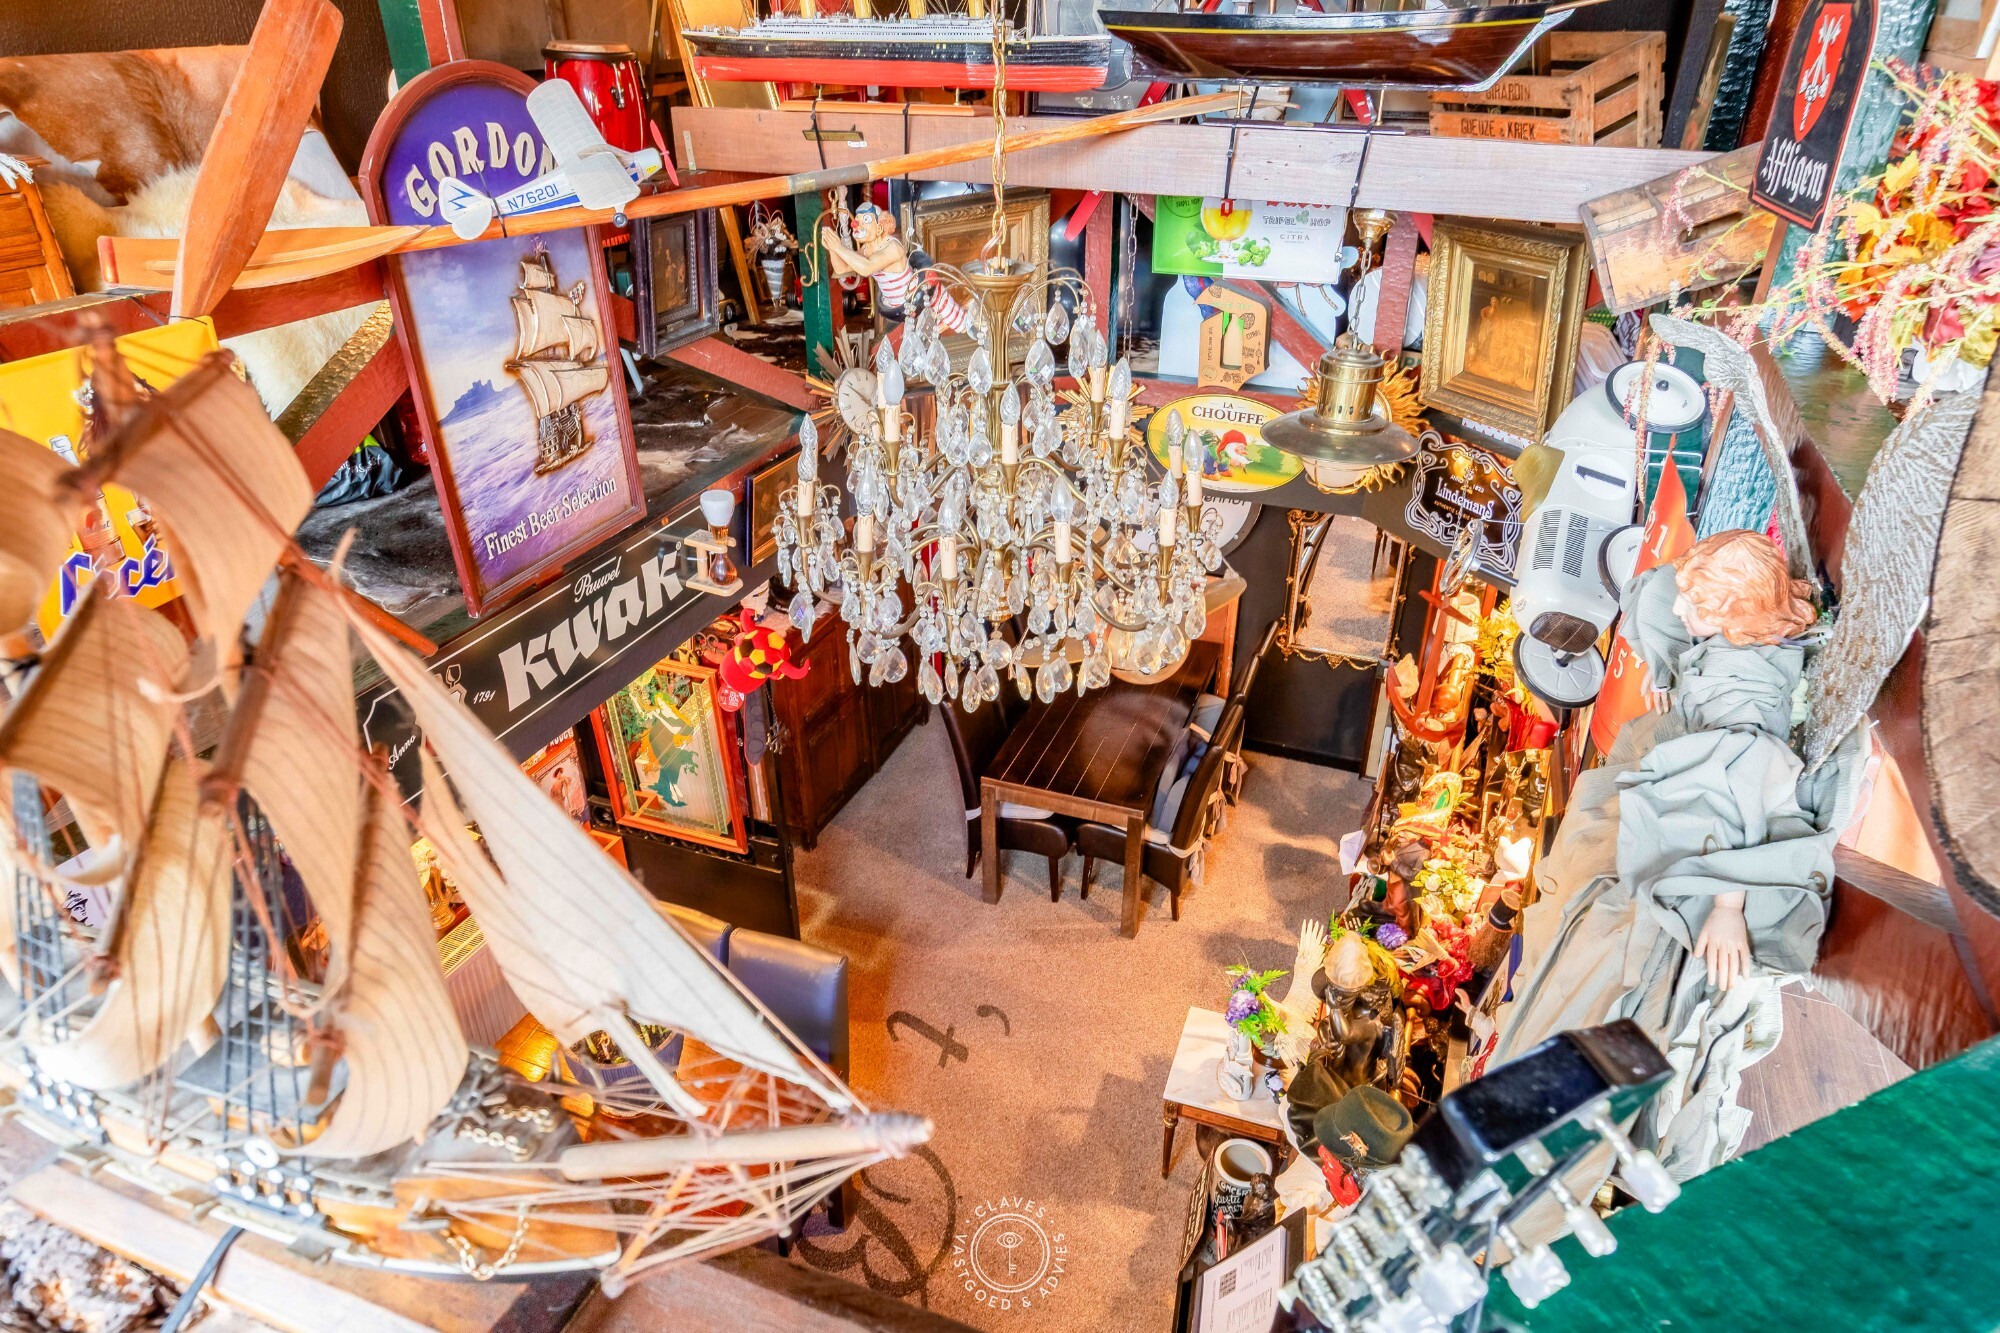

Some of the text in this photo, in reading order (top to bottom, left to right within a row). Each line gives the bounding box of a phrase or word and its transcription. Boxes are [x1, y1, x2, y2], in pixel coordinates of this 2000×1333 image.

[1486, 83, 1530, 100] GIRARDIN
[1461, 118, 1496, 137] GUEUZE
[1507, 121, 1536, 139] KRIEK
[1760, 136, 1828, 203] Affligem
[507, 184, 560, 211] N76201
[1262, 215, 1331, 227] TRIPEL HOP
[1191, 405, 1265, 426] CHOUFFE
[1223, 401, 1234, 410] LA
[483, 476, 618, 561] Finest Beer Selection
[574, 555, 623, 603] Pauwel
[388, 689, 495, 773] Anno 1791
